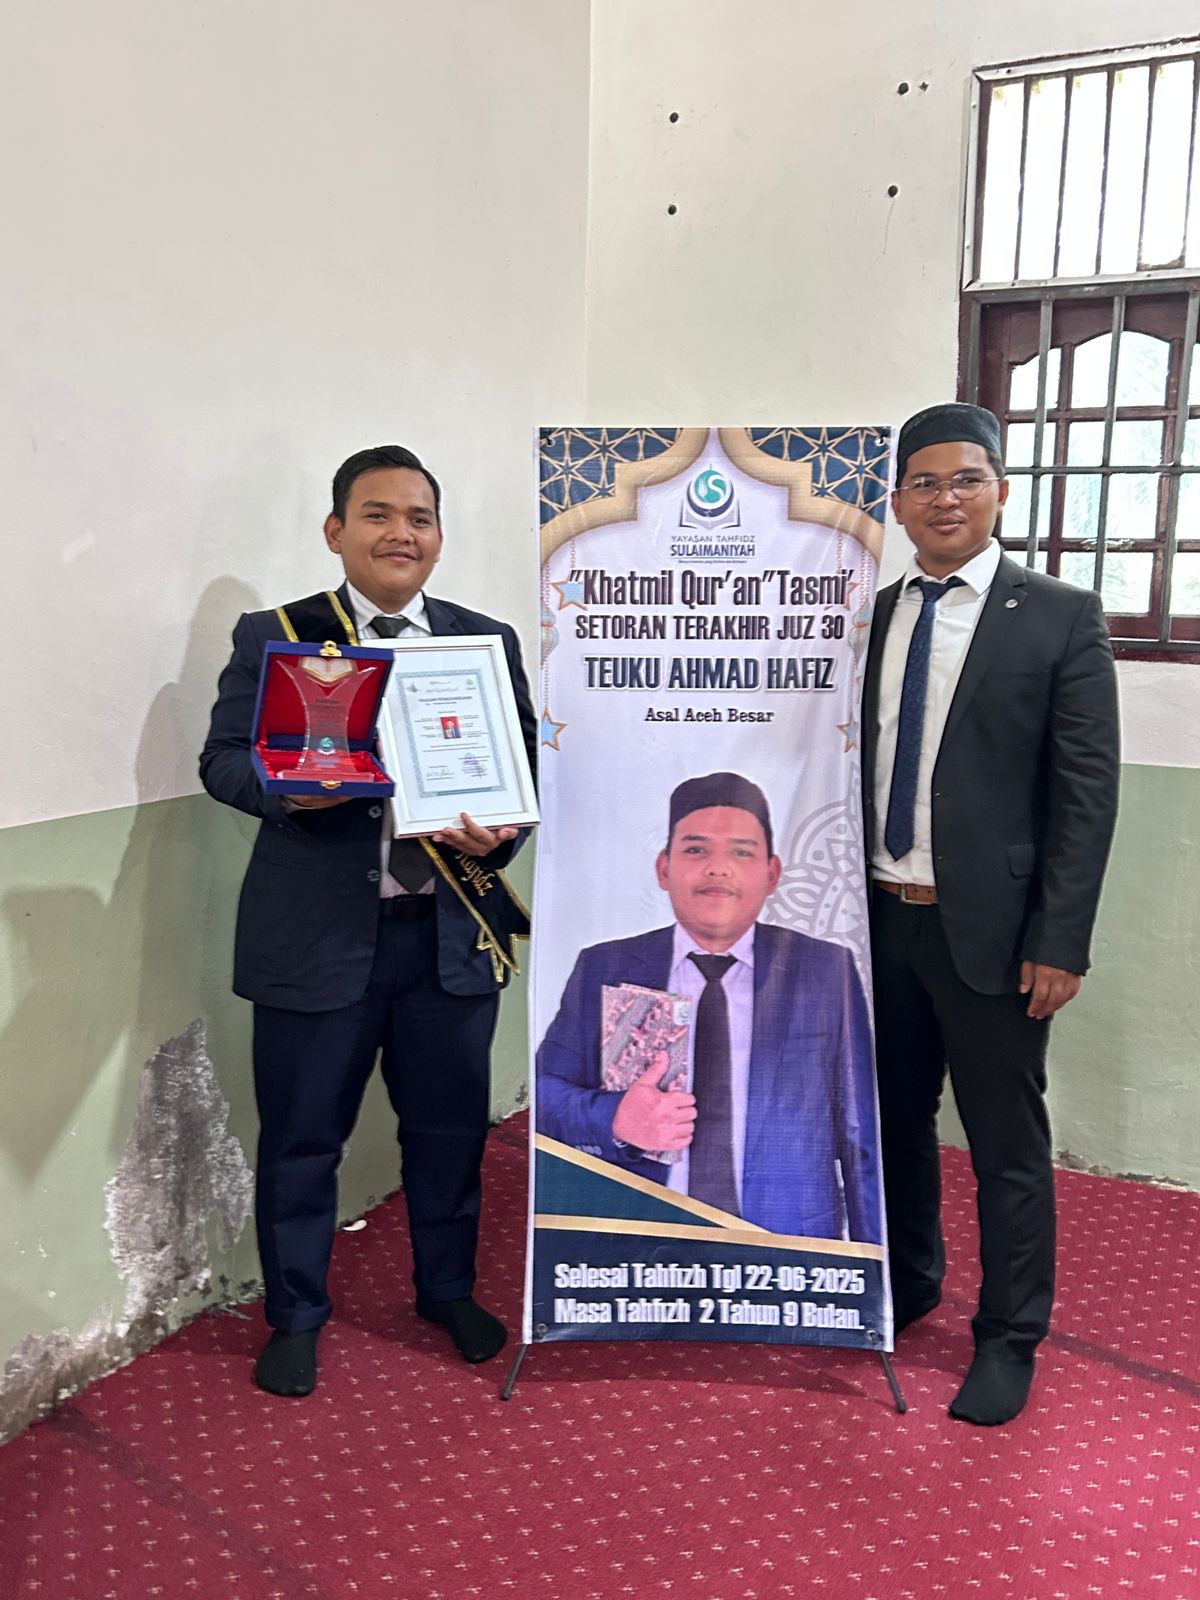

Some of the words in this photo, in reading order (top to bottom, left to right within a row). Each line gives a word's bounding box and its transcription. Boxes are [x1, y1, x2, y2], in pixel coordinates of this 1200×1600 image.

[670, 544, 756, 556] SULAIMANIYAH
[671, 535, 713, 543] YAYASAN
[716, 535, 756, 543] TAHFIDZ
[575, 614, 667, 640] SETORAN
[673, 615, 771, 640] TERAKHIR
[777, 615, 816, 640] JUZ
[821, 614, 845, 640] 30
[583, 656, 661, 689] TEUKU
[668, 656, 760, 690] AHMAD
[766, 656, 836, 690] HAFIZ
[645, 707, 680, 722] Asal
[683, 707, 722, 722] Aceh
[727, 707, 775, 722] Besar
[554, 1262, 629, 1289] Selesai
[631, 1262, 707, 1289] Tahfizh
[710, 1263, 742, 1293] Tgl
[744, 1264, 865, 1295] 22-06-2025
[553, 1298, 612, 1324] Masa
[615, 1298, 691, 1323] Tahfizh
[698, 1298, 715, 1324] 2
[718, 1298, 780, 1326] Tahun
[782, 1301, 799, 1327] 9
